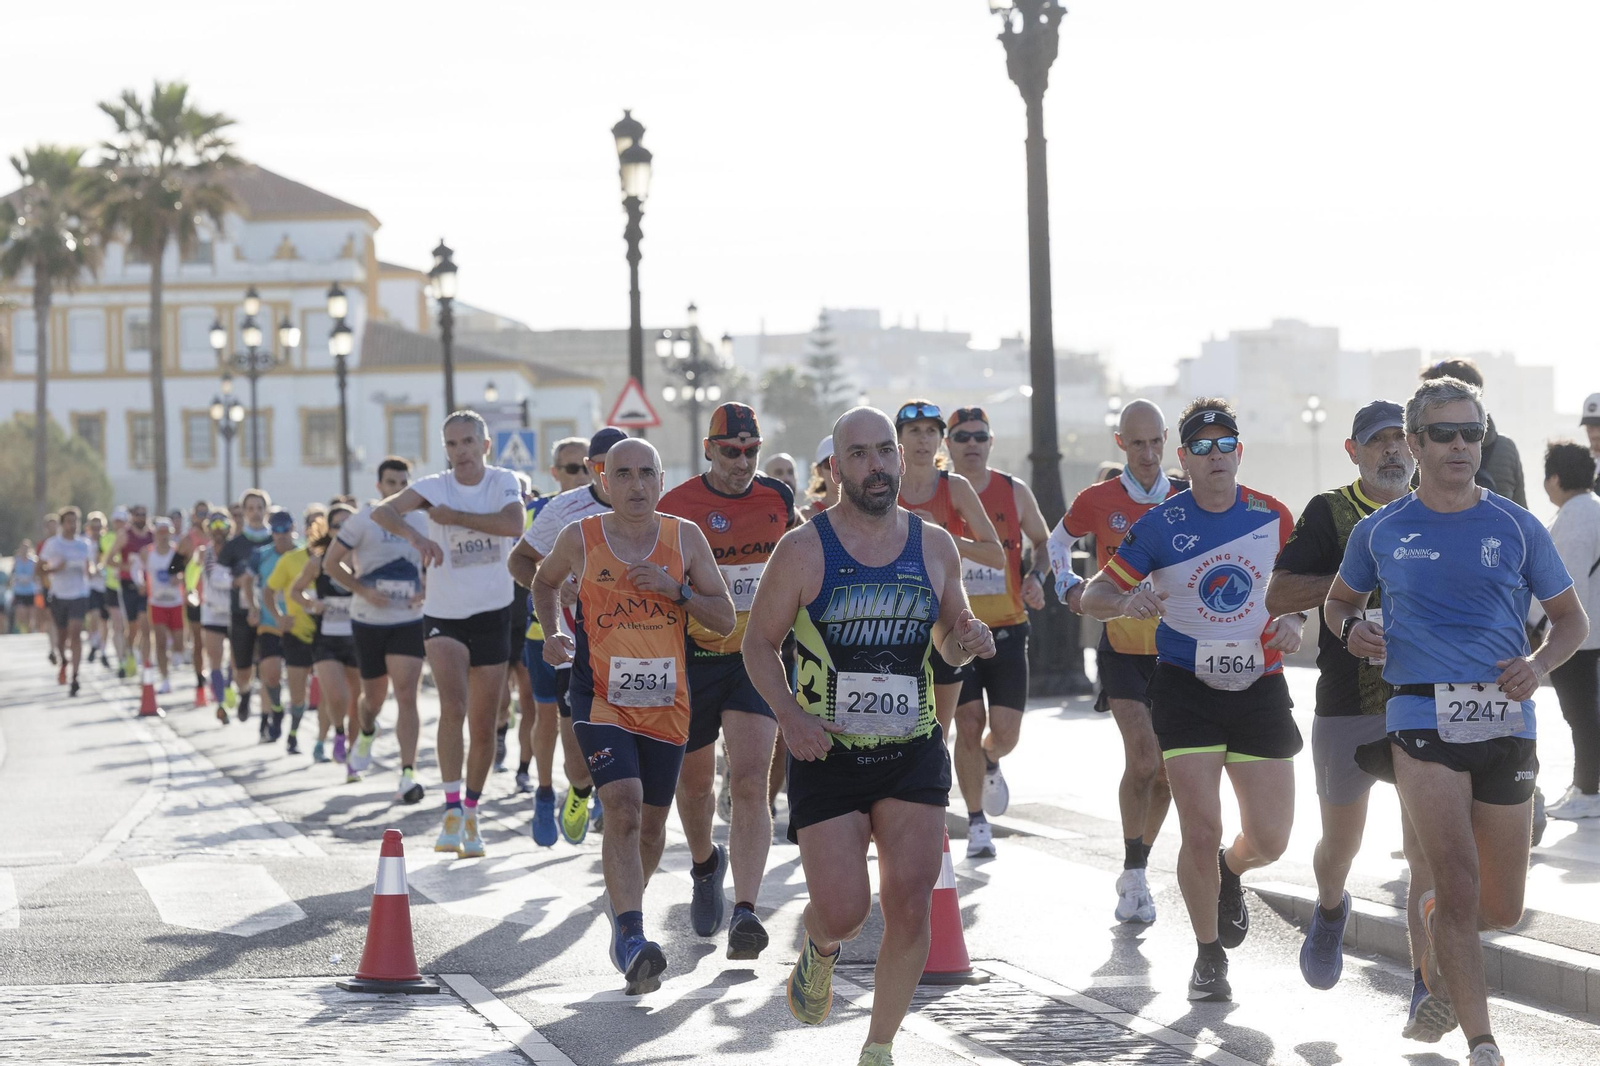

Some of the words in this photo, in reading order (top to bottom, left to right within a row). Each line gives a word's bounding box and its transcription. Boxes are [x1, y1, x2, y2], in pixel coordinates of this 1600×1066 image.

[456, 538, 492, 554] 1691
[1187, 553, 1231, 589] RUNNING
[1237, 555, 1262, 580] TEAM
[596, 598, 678, 629] CAMAS
[819, 583, 932, 622] AMATE
[1197, 601, 1255, 623] ALGECIRAS
[617, 621, 664, 631] Atletismo
[826, 619, 932, 647] RUNNERS
[1205, 654, 1256, 674] 1564
[619, 672, 668, 690] 2531
[846, 691, 909, 716] 2208
[1448, 700, 1509, 723] 2247
